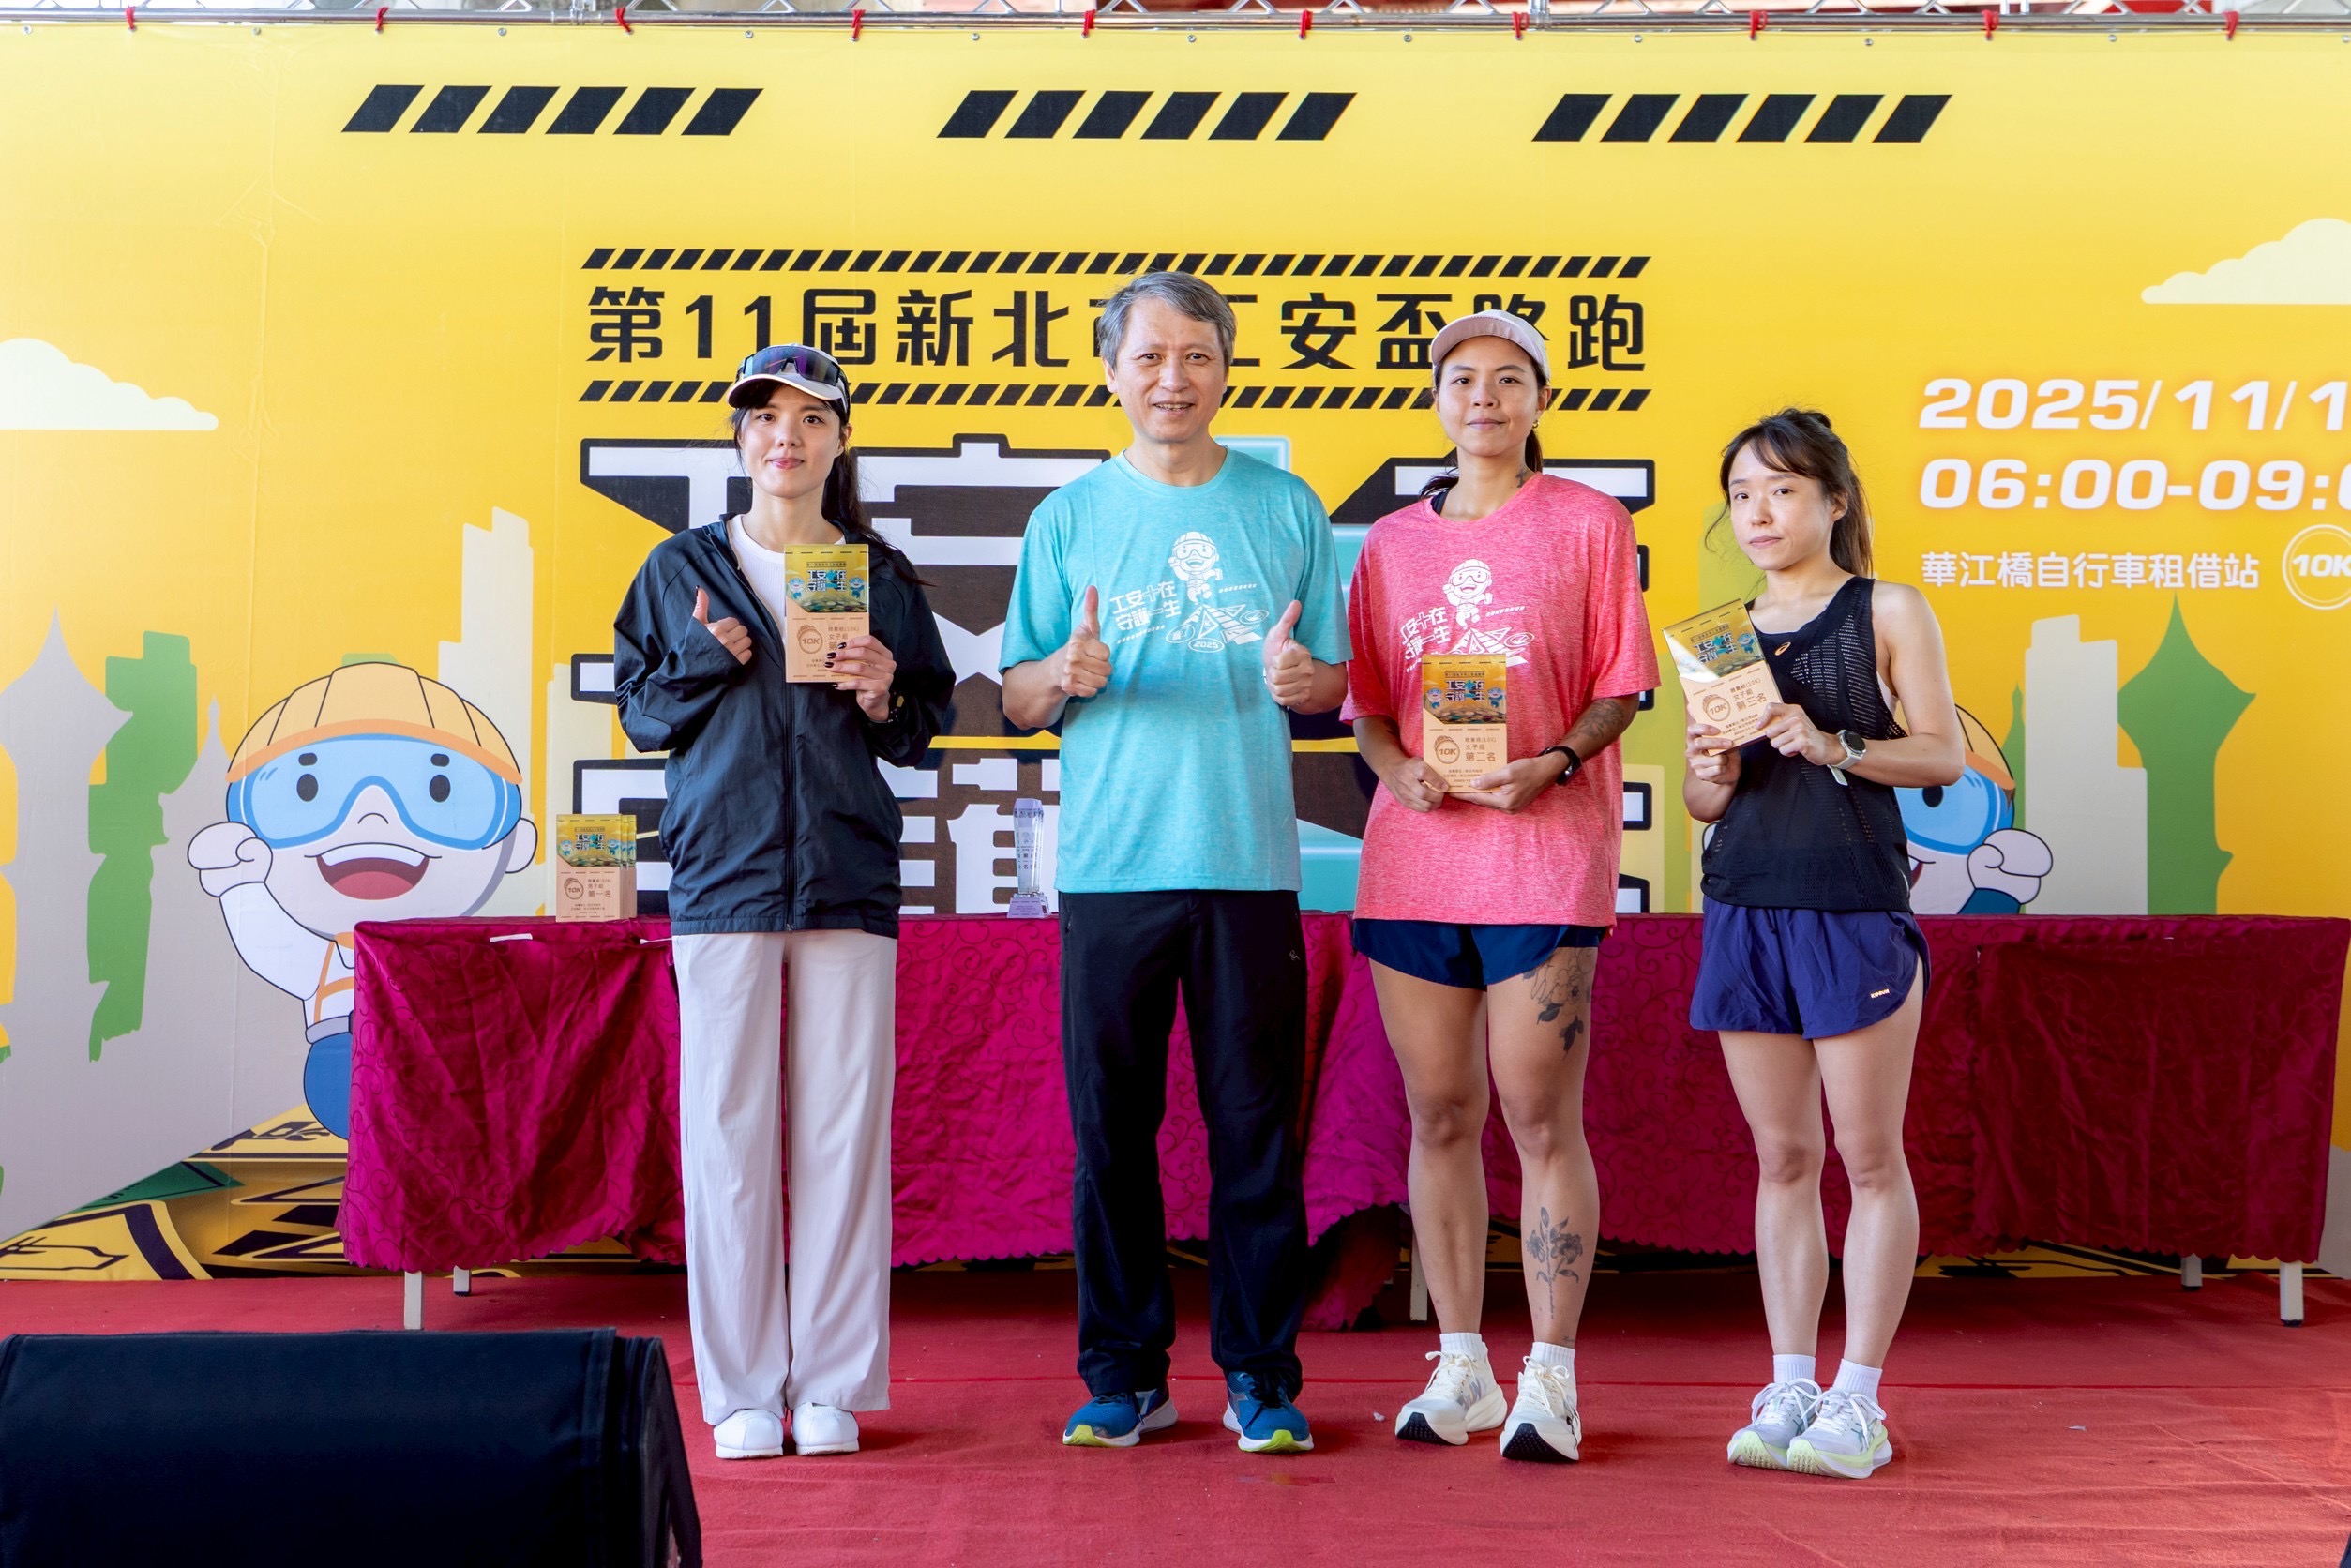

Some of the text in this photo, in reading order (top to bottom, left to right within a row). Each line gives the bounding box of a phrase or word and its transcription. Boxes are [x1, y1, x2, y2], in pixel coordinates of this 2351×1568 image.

[585, 286, 1646, 371] 第11屆新北安盃跑
[1920, 458, 2351, 510] 06:00-09:
[1921, 551, 2260, 589] 華江橋自行車租借站
[2292, 554, 2351, 577] 10K
[1115, 599, 1182, 630] 守護一生
[802, 637, 820, 645] 10K
[1193, 641, 1219, 649] 2025
[1710, 702, 1727, 715] 10K
[1736, 693, 1768, 712] 第三名
[1465, 752, 1496, 761] 第二名
